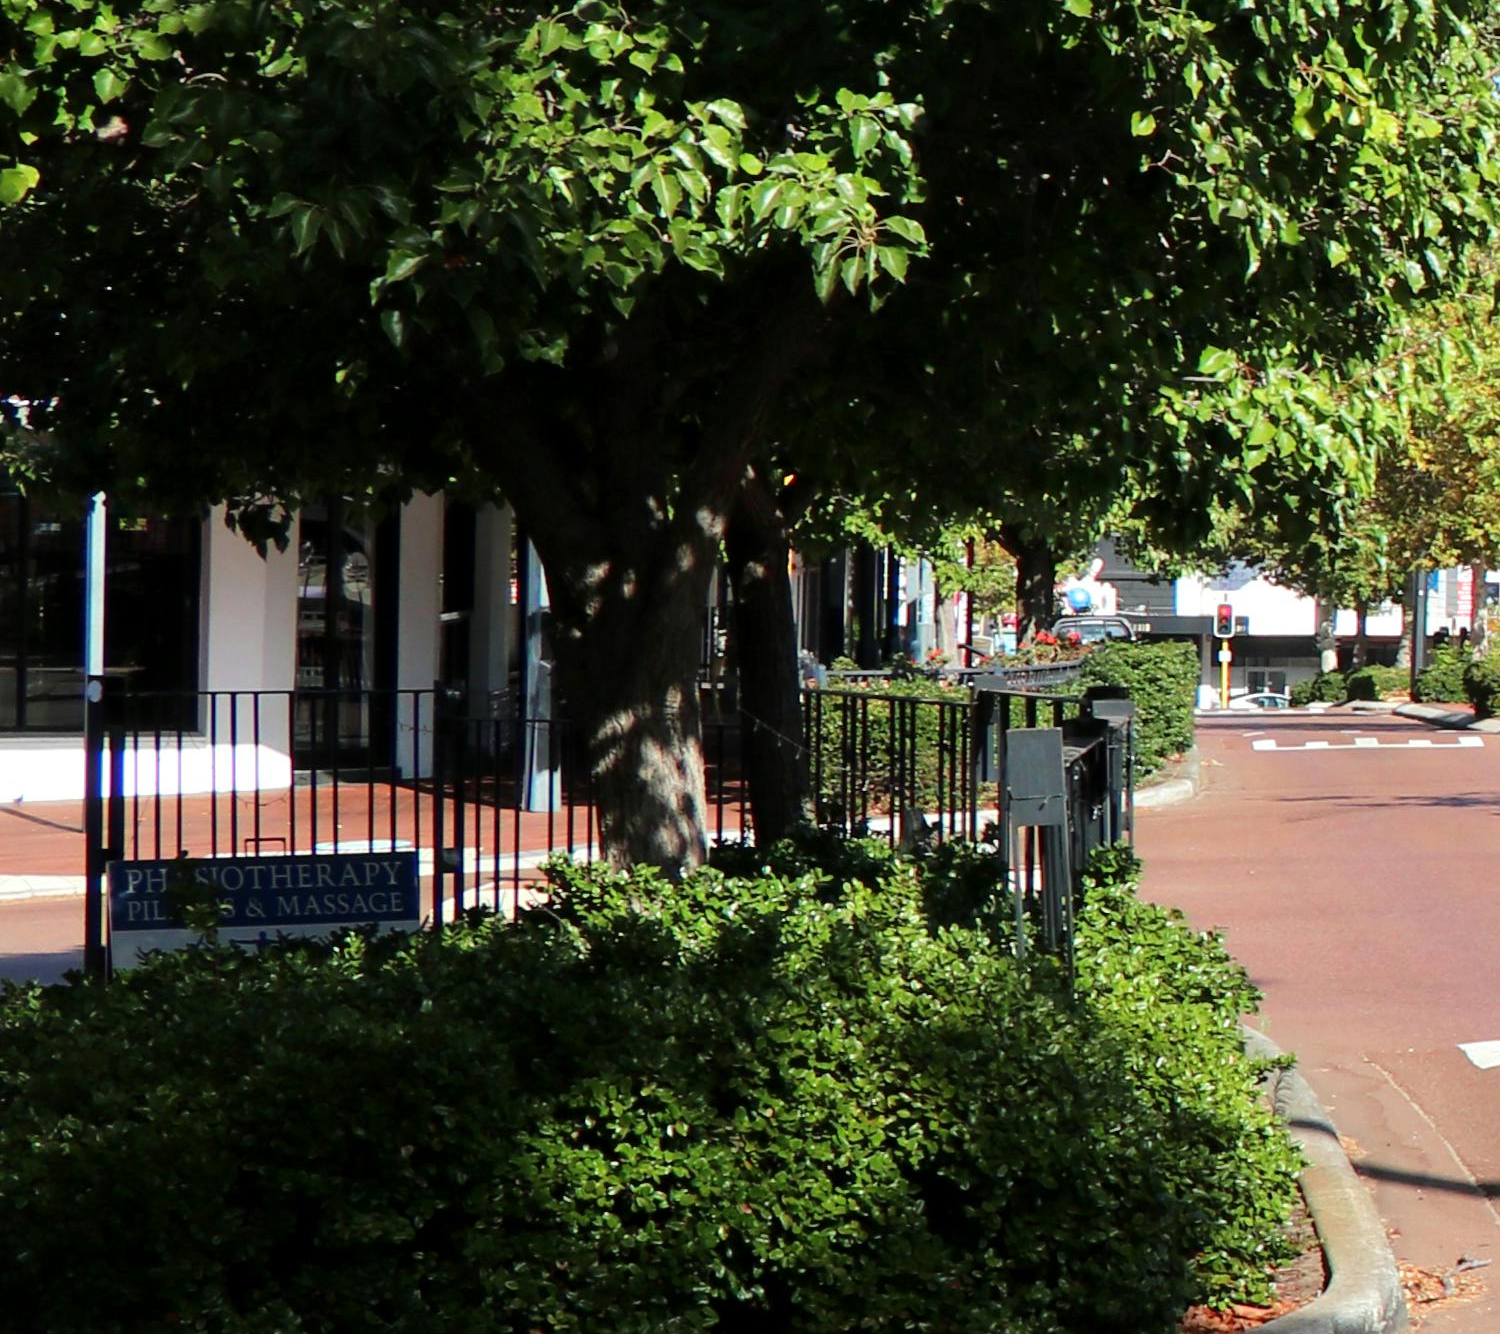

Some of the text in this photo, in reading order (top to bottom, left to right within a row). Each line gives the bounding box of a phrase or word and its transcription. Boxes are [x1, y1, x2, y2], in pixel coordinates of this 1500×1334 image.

[125, 861, 403, 895] PHSIOTHERAPY
[126, 892, 404, 922] PILS & MASSAGE
